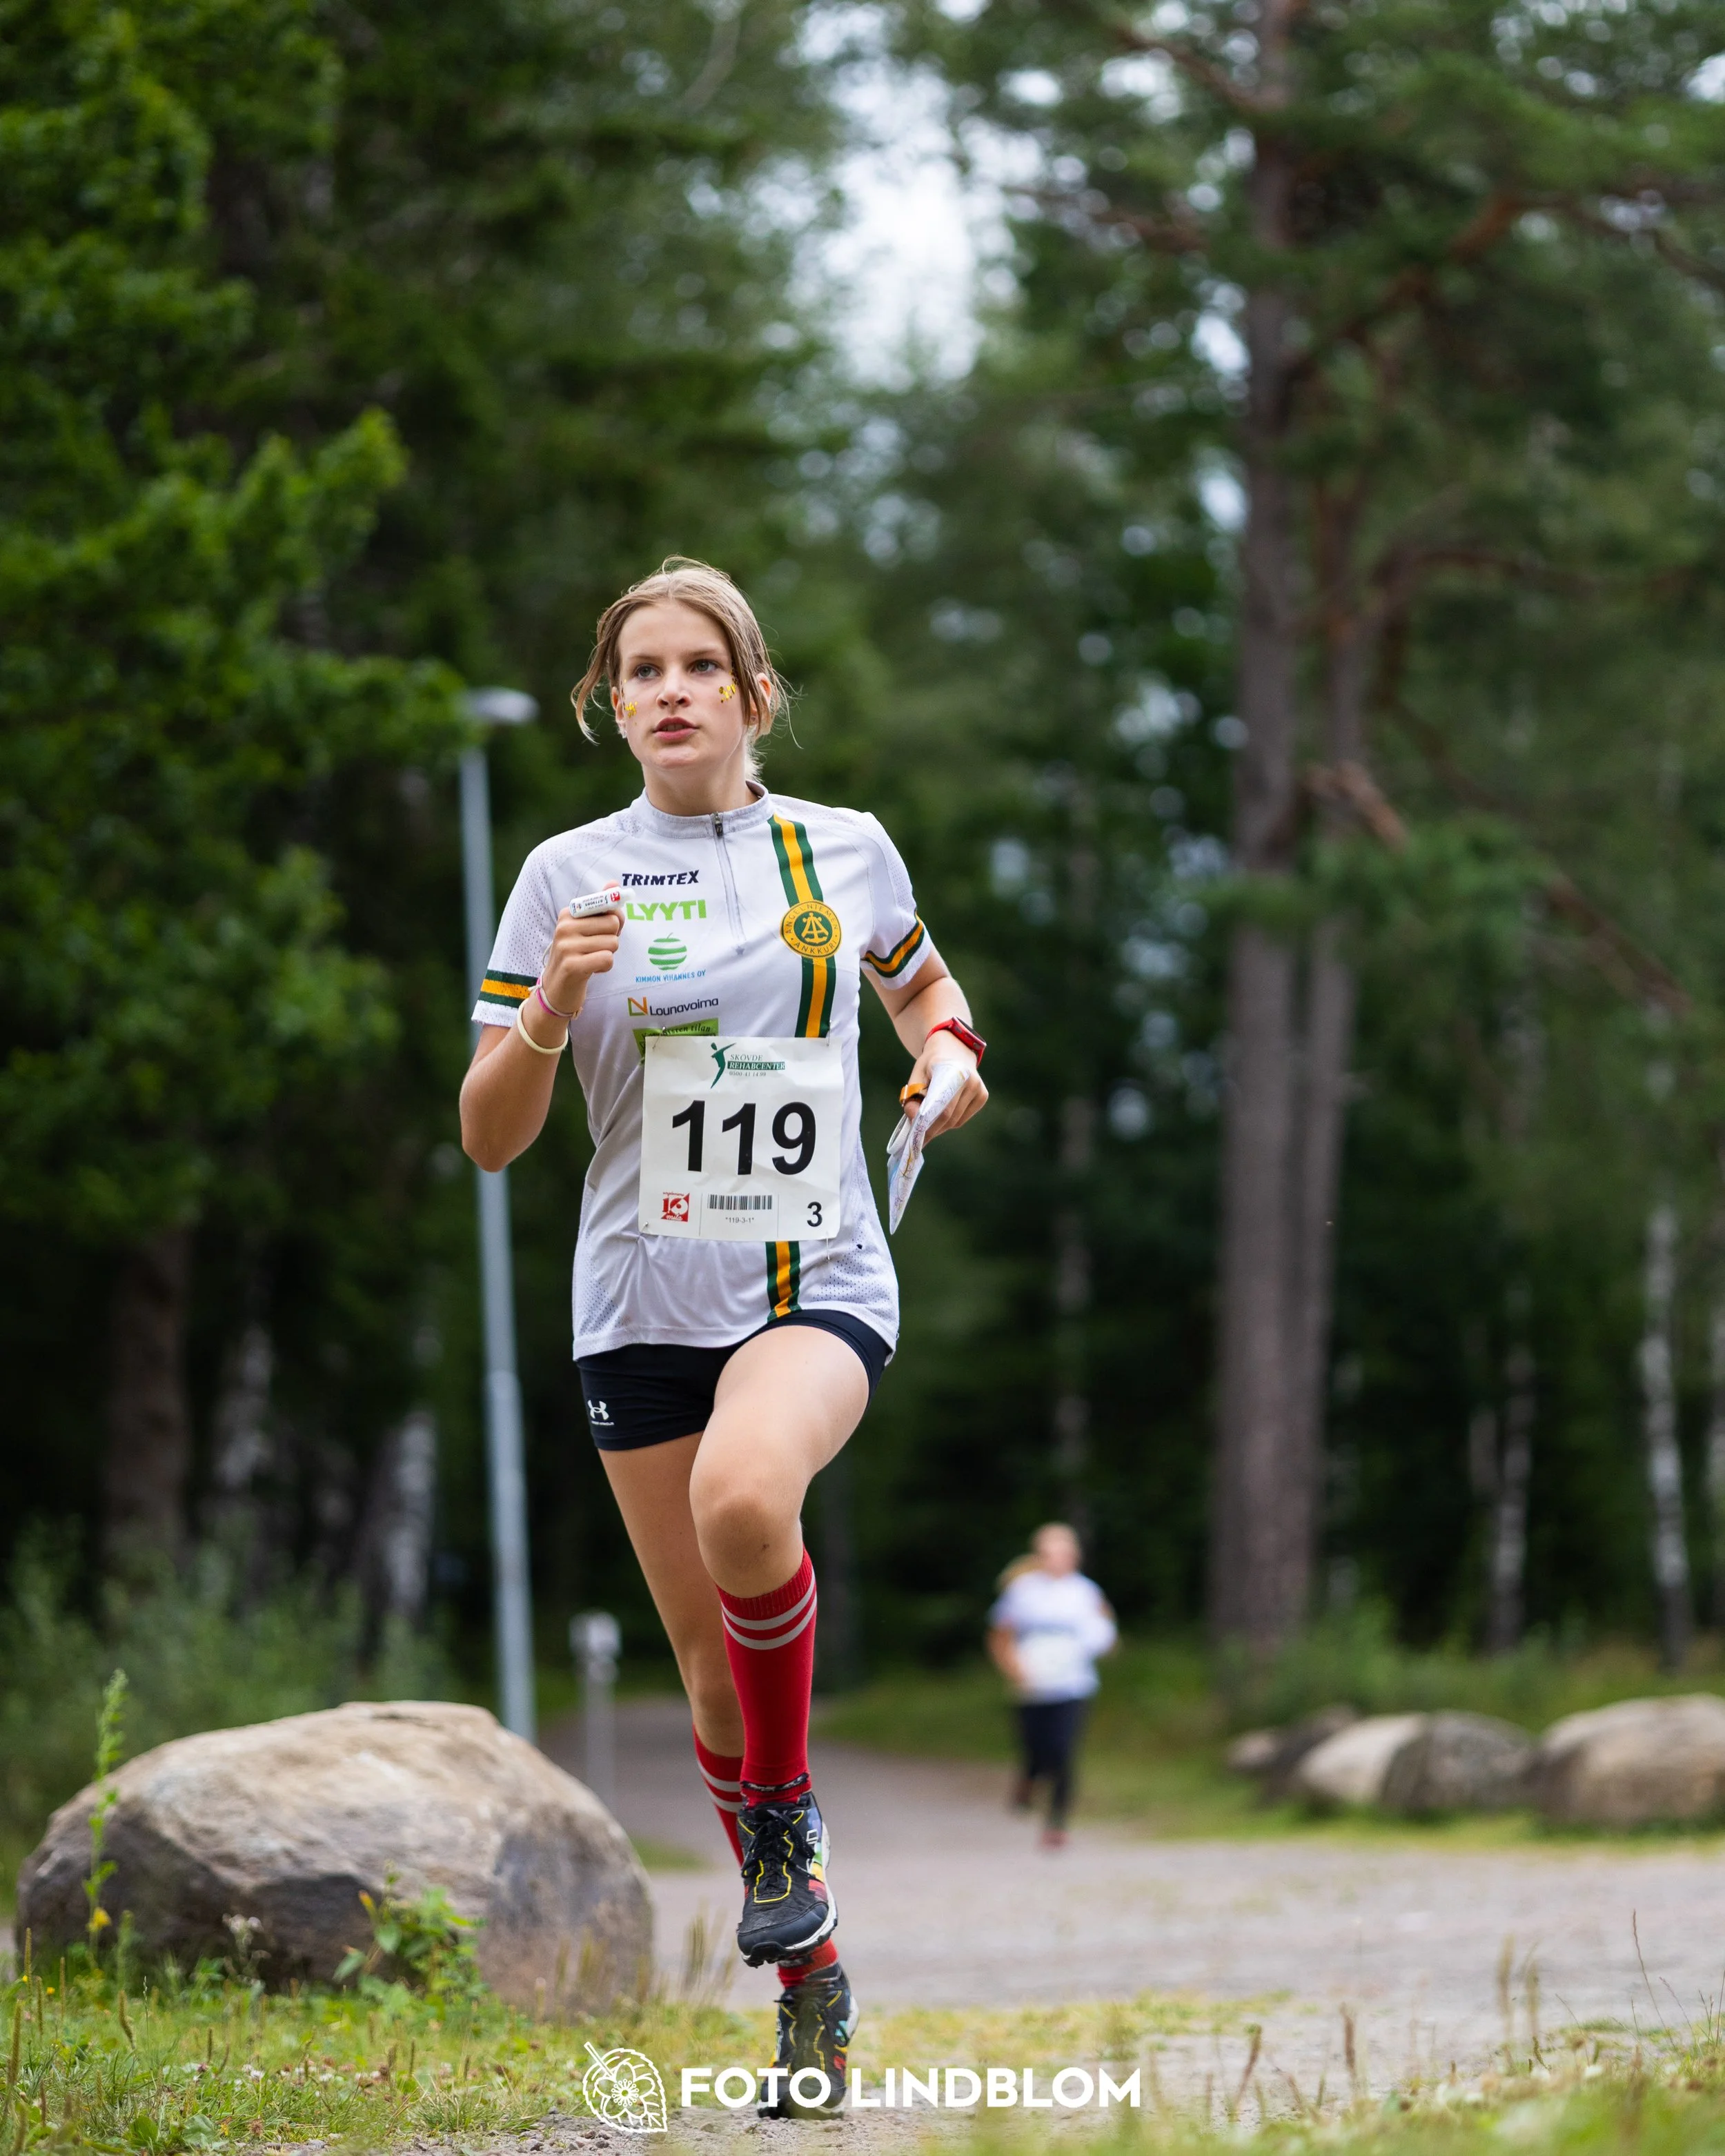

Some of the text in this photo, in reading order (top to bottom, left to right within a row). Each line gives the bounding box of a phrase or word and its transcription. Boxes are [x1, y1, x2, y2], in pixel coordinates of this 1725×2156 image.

[622, 869, 700, 887] TRIMTEX
[625, 899, 707, 921] LYYTI
[794, 940, 837, 954] ANKKURI
[649, 998, 718, 1016] Lounavoima
[729, 1062, 785, 1070] REHABCENTER
[672, 1099, 816, 1176] 119
[806, 1201, 823, 1227] 3
